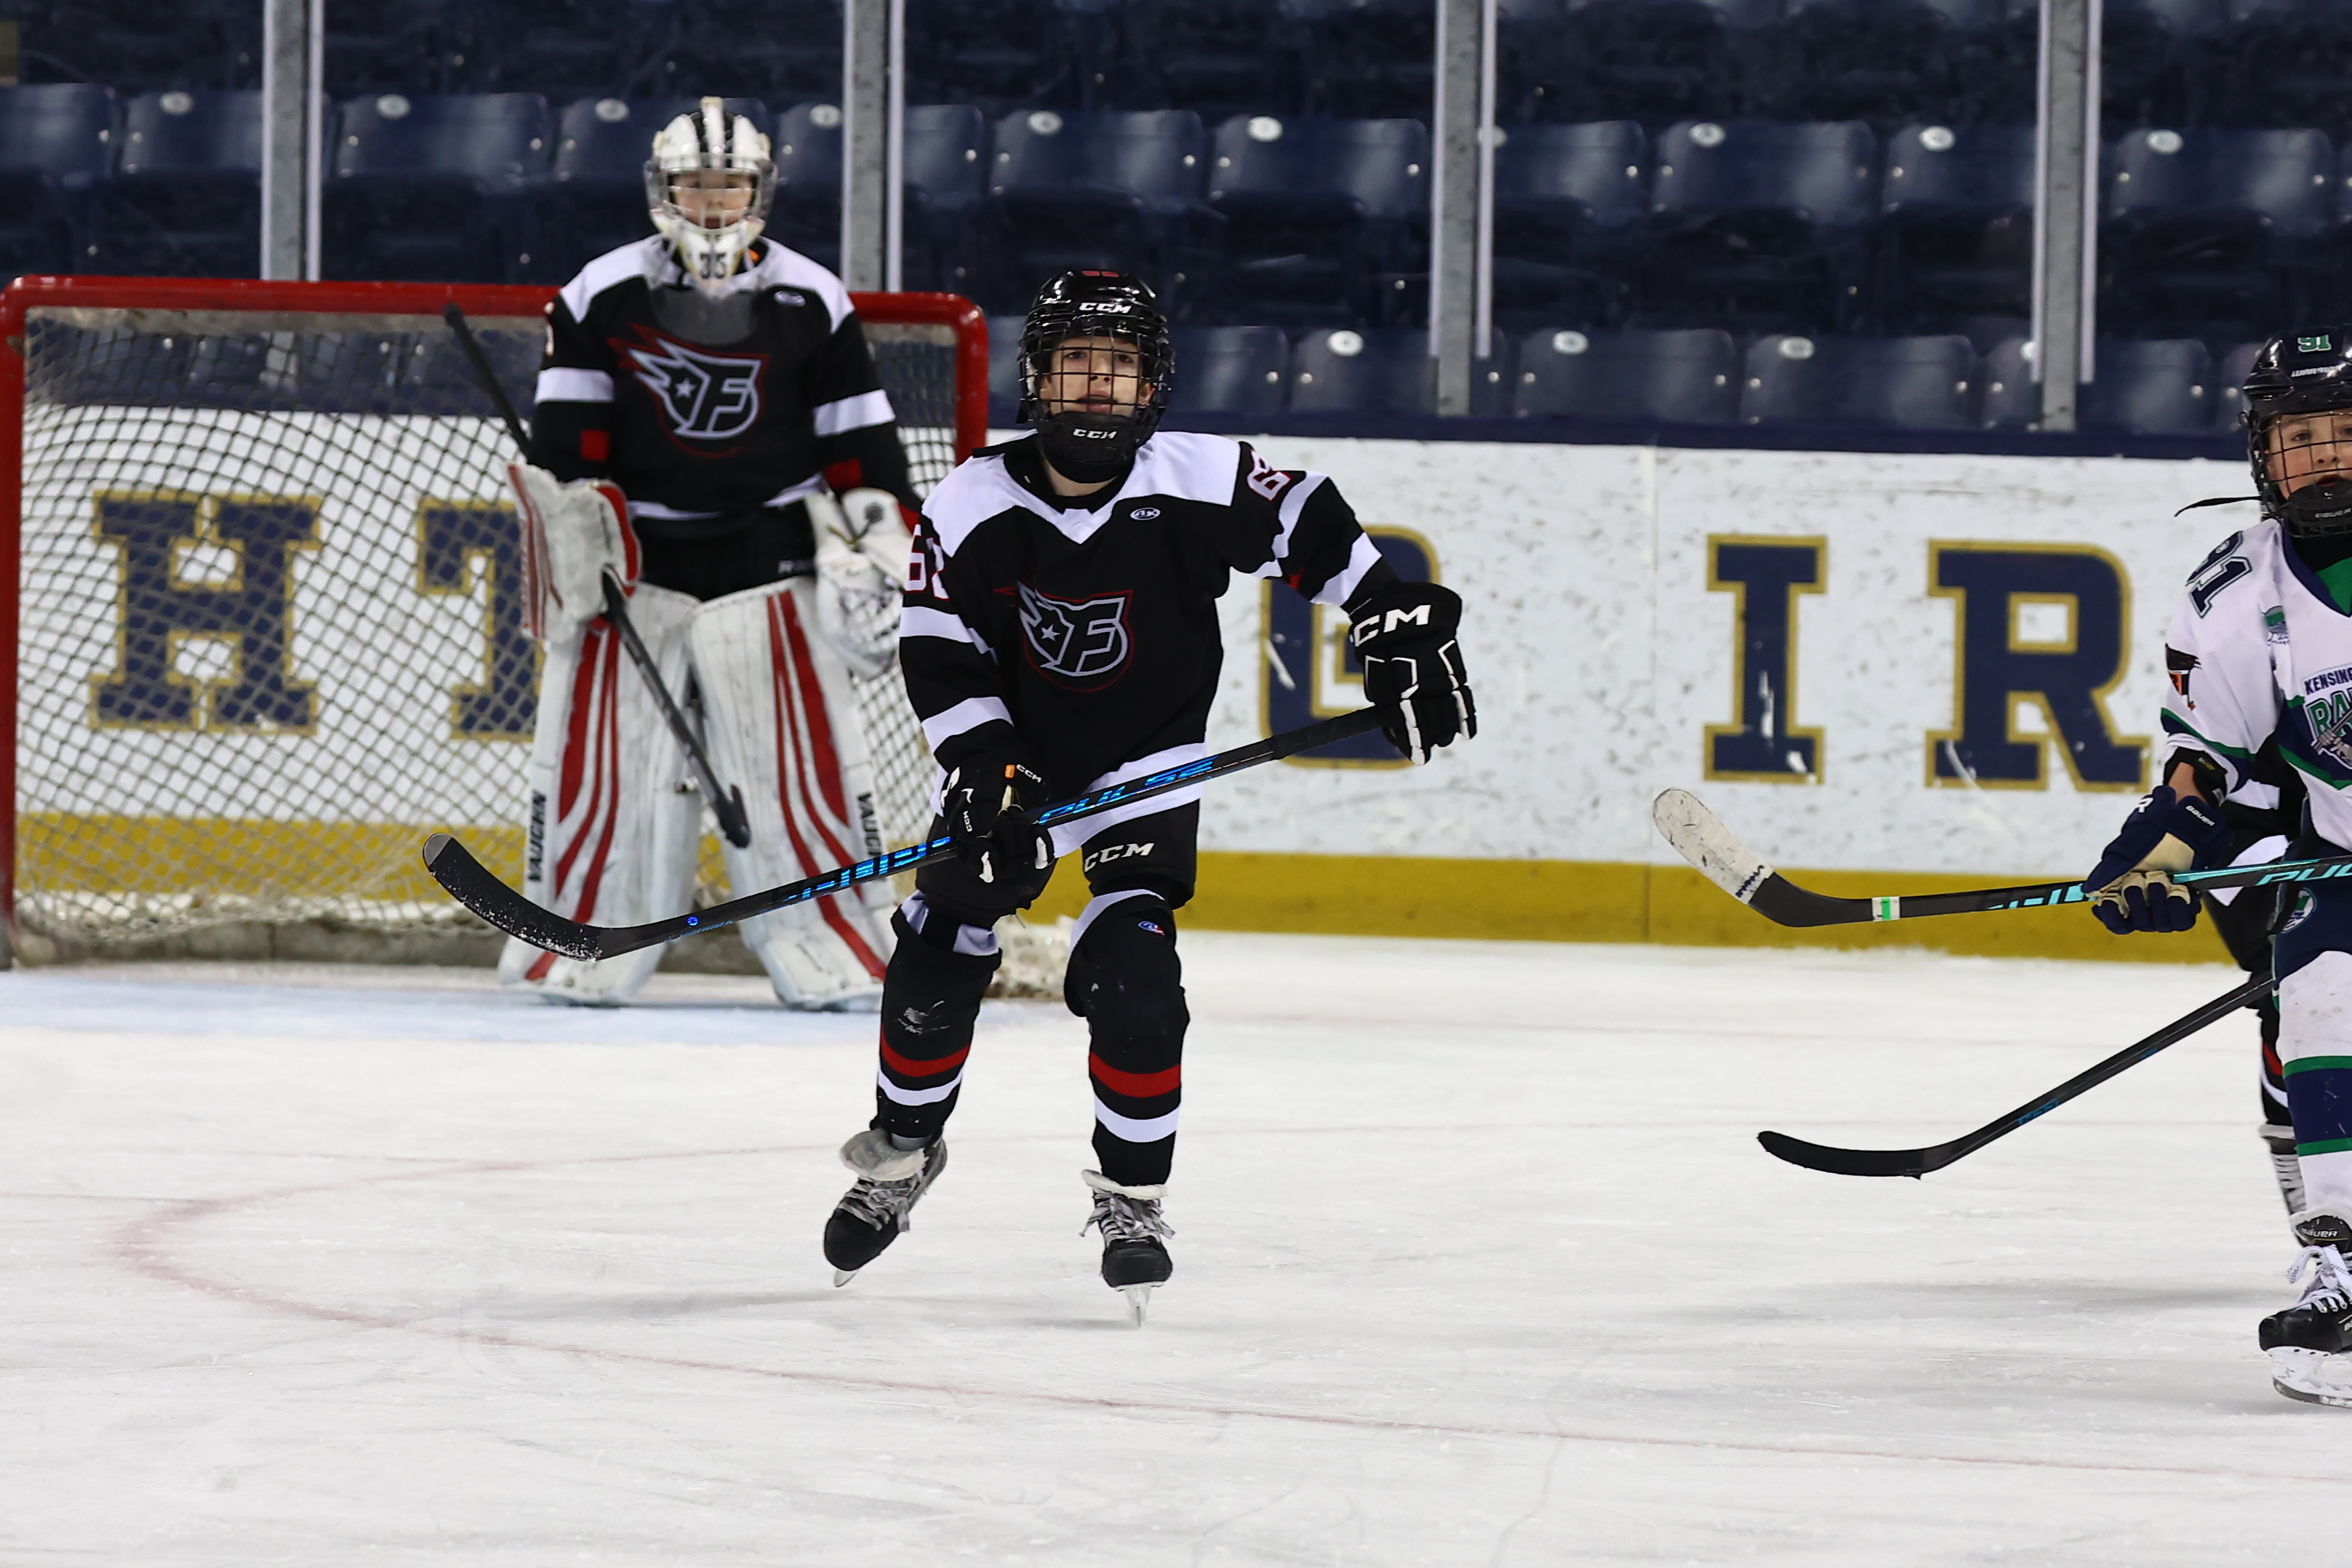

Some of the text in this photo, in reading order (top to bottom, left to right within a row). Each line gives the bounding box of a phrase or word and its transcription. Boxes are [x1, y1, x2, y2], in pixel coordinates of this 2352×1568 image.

[1079, 302, 1132, 313] CCM
[1072, 428, 1118, 439] CCM
[1349, 604, 1432, 648] CM
[1016, 764, 1042, 783] CCM
[963, 810, 973, 832] CCM
[1083, 842, 1155, 873] CCM
